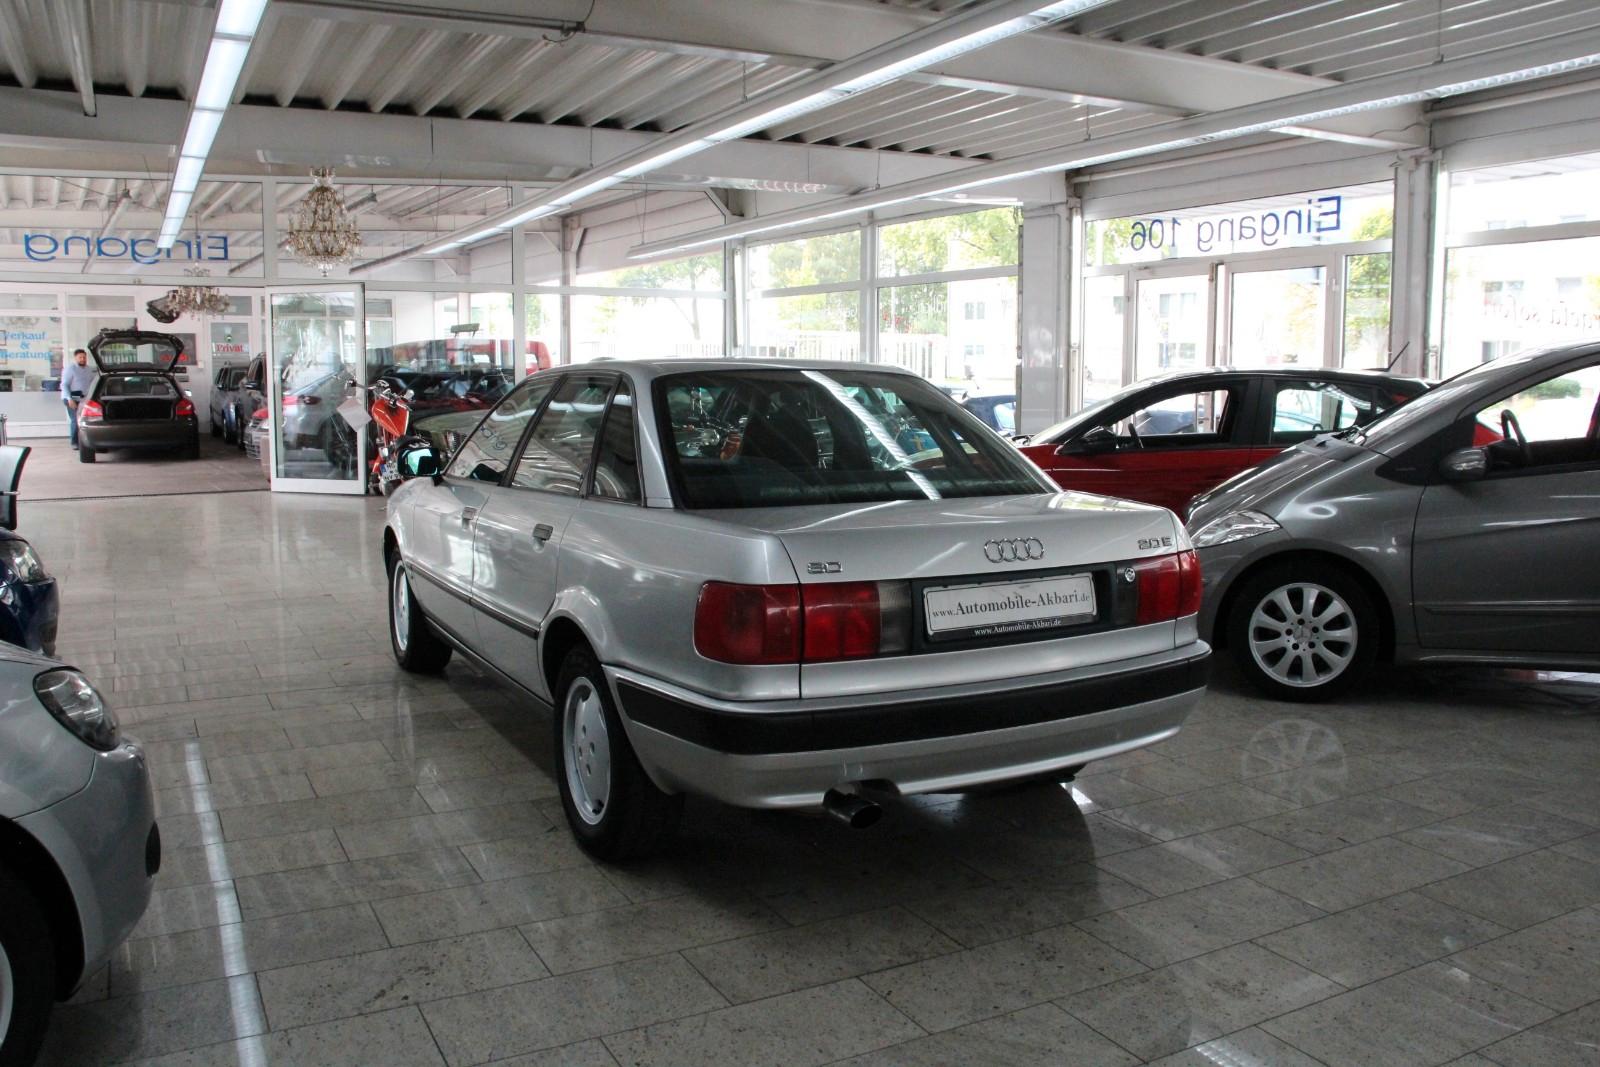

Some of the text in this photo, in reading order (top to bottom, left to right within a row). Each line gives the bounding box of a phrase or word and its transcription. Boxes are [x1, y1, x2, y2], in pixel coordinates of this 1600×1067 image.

[216, 343, 244, 353] Privat
[931, 590, 1091, 617] www.Automobile-Akbari.de
[974, 618, 1062, 636] www.Automobile-Akbari.de
